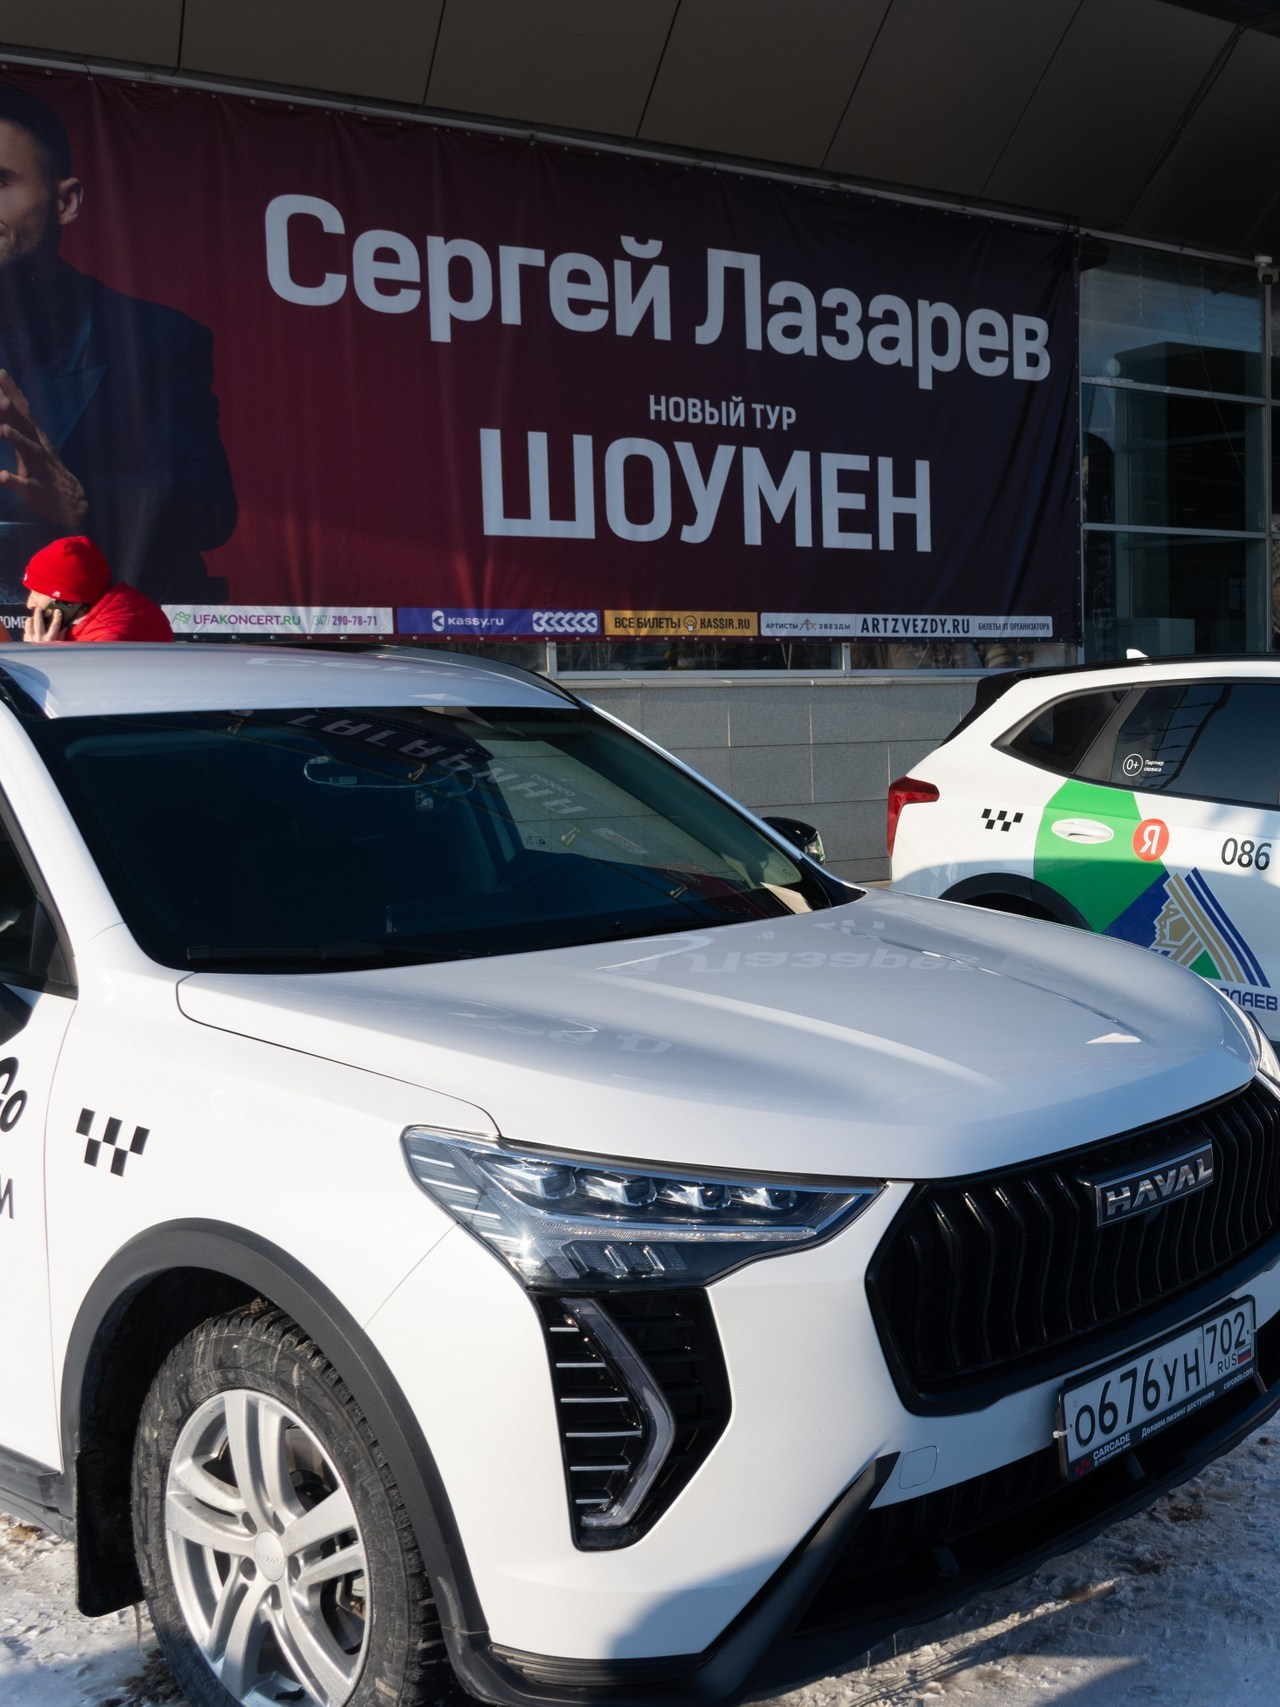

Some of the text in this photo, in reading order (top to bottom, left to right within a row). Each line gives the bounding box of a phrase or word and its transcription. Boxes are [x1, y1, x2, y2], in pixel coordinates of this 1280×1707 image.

[265, 194, 1051, 389] Сергей Лазарев
[648, 394, 797, 431] НОВЫЙ ТУР
[479, 428, 932, 553] ШОУМЕН
[193, 614, 301, 626] UFAKONCERT.RU
[332, 615, 378, 626] 290-78-71
[448, 617, 505, 628] kassy.ru
[614, 617, 750, 629] ВСЕ БИЛЕТЫ KASSIR.RU
[861, 617, 970, 634] ARTZVEZDY.RU
[1139, 824, 1161, 855] Я
[1220, 837, 1273, 871] 086
[1219, 987, 1279, 1011] ЛАЕВ
[1106, 1158, 1213, 1216] HAVAL
[1205, 1311, 1246, 1365] 702
[1217, 1352, 1237, 1376] RUS
[1223, 1367, 1254, 1390] carcade.com
[1093, 1432, 1131, 1460] CARCADE
